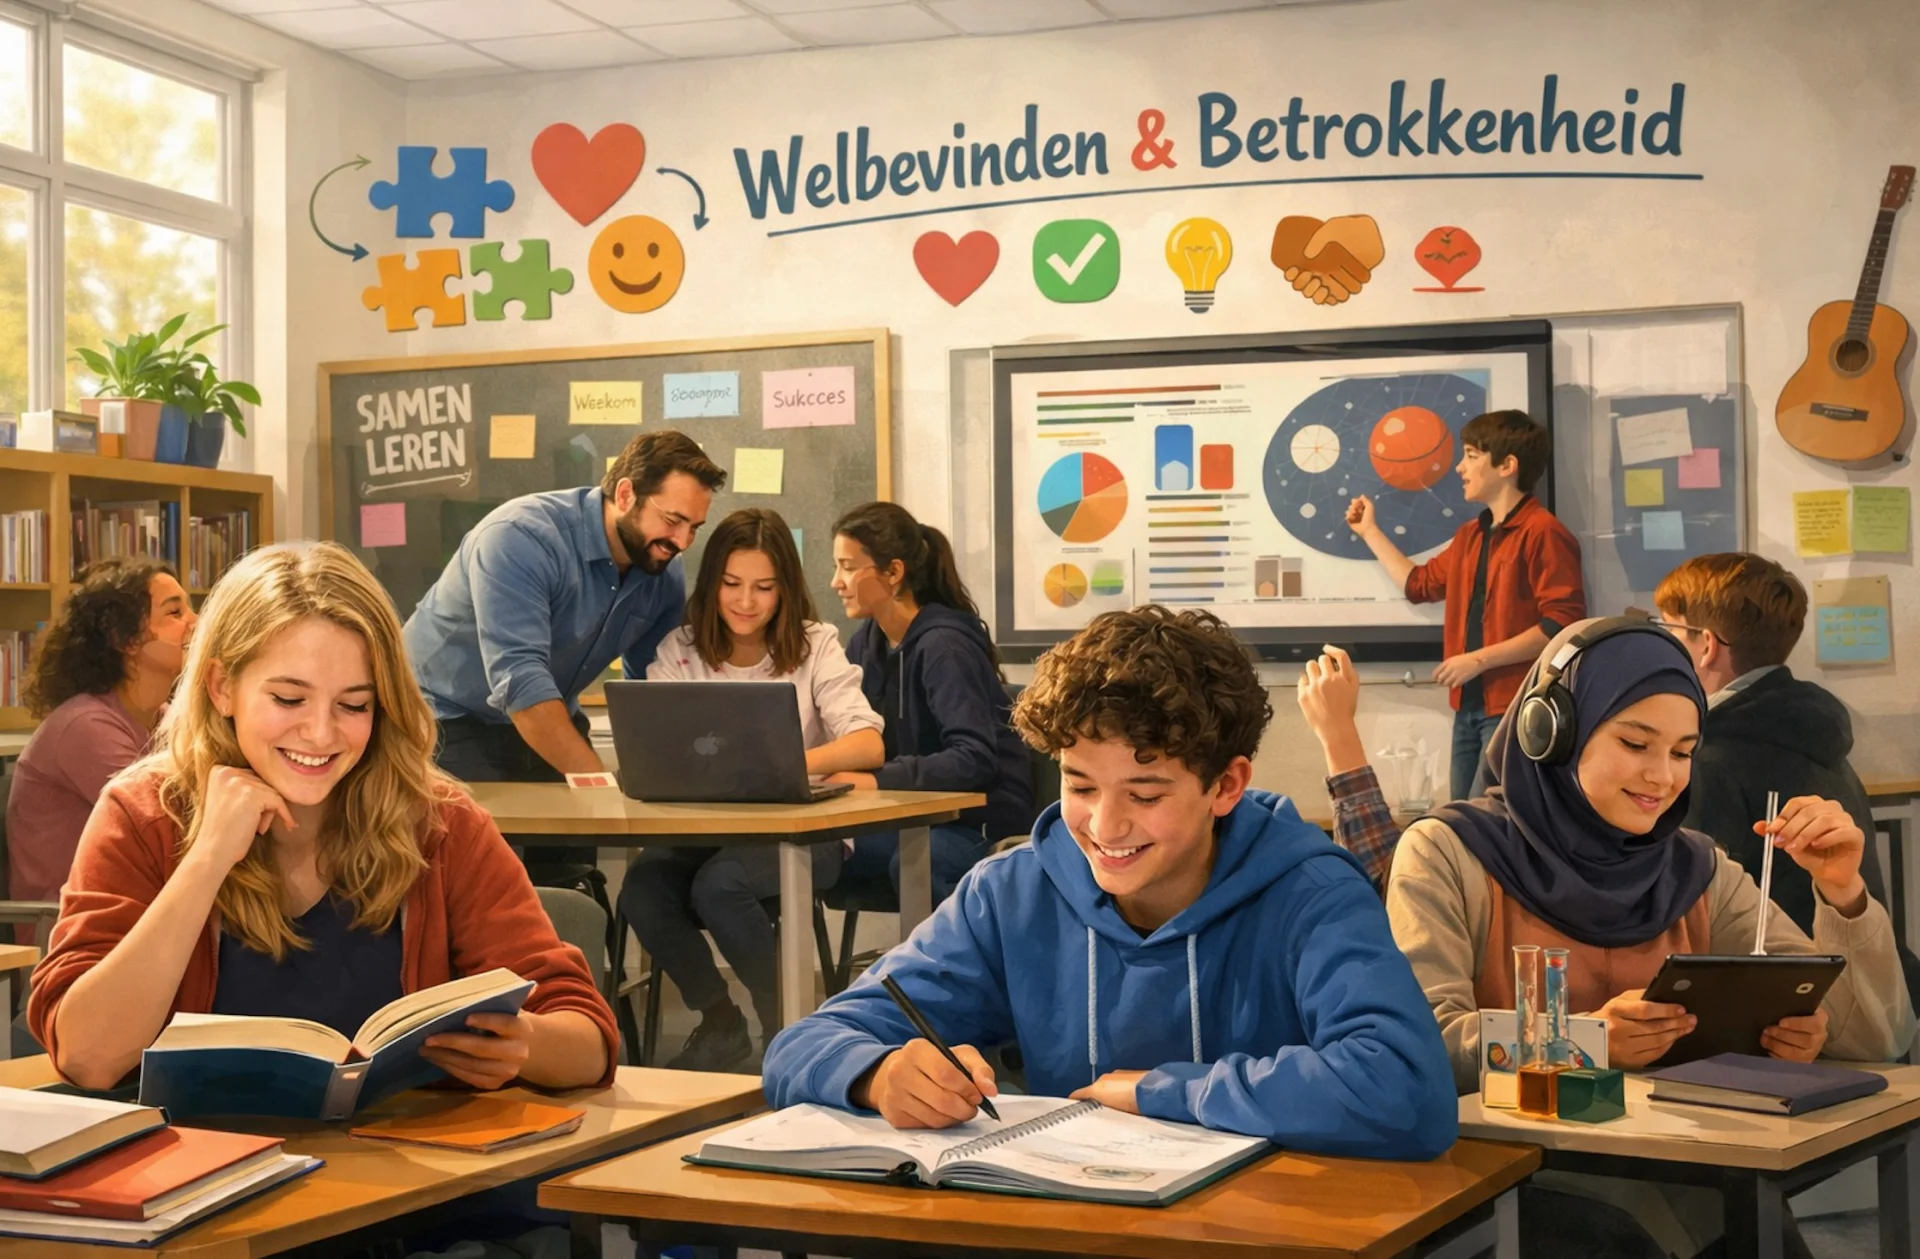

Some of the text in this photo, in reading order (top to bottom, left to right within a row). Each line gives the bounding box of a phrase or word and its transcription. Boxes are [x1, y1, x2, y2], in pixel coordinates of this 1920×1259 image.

[733, 73, 1687, 220] Welbevinden & Betrokkenheid
[356, 382, 473, 433] SAMEN
[772, 388, 846, 409] Sukcces
[365, 427, 467, 477] LEREN
